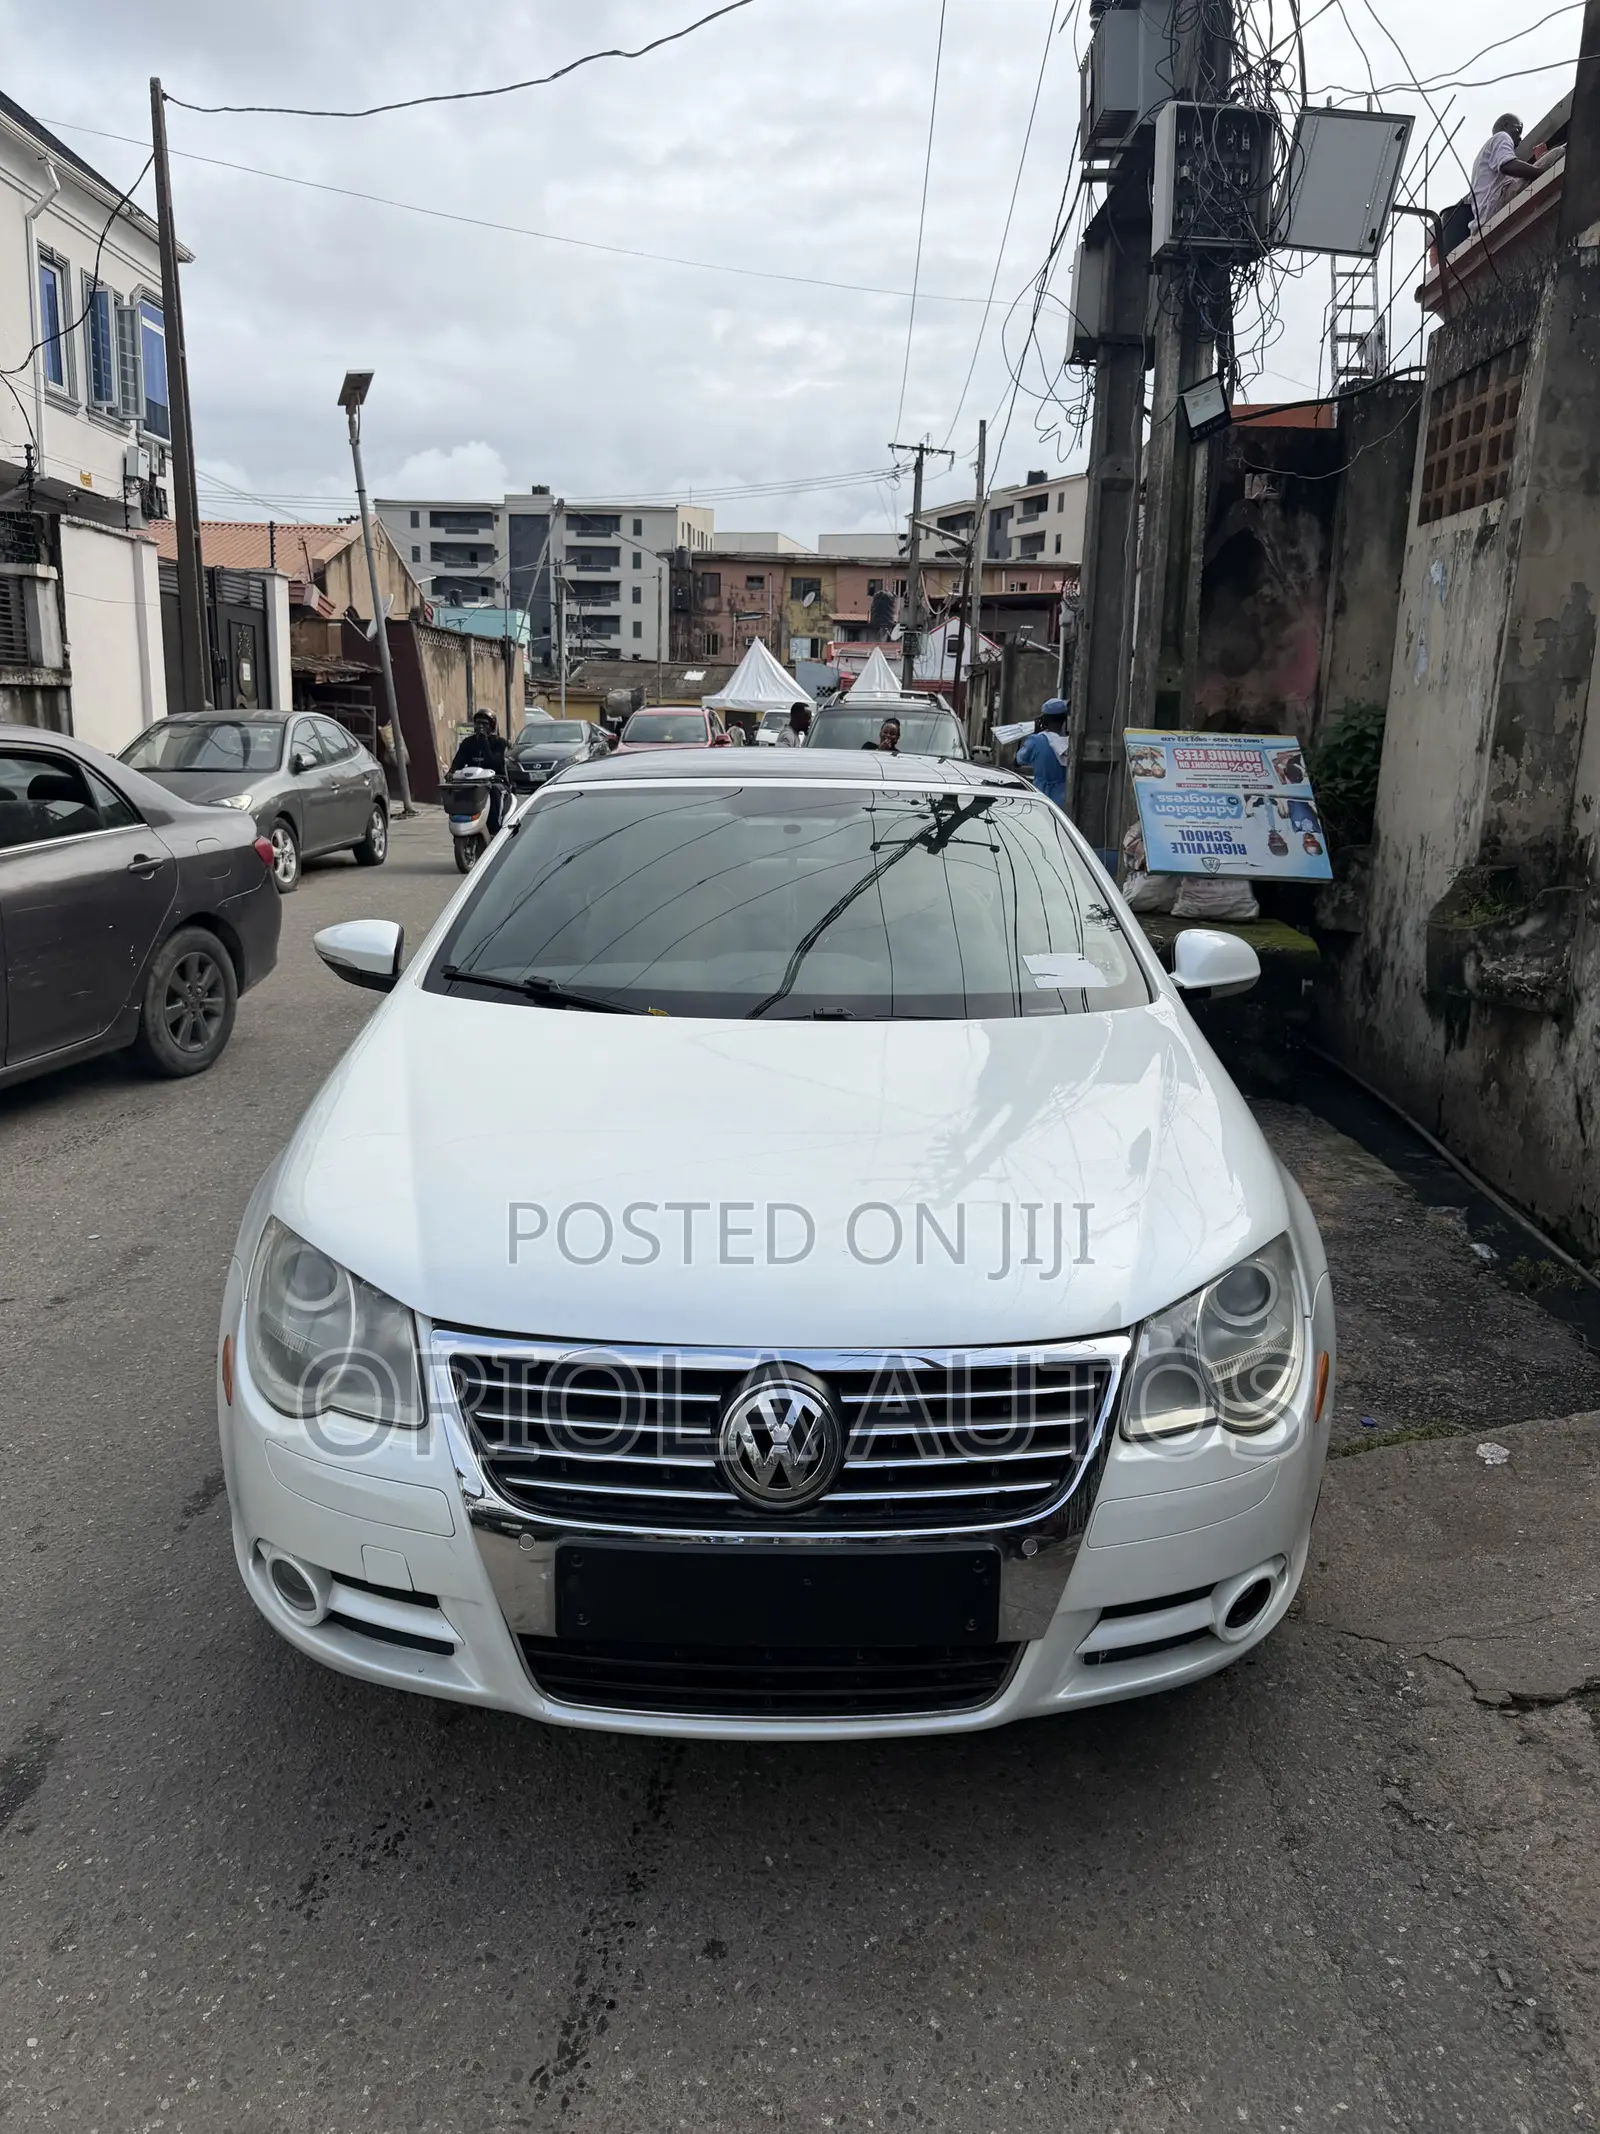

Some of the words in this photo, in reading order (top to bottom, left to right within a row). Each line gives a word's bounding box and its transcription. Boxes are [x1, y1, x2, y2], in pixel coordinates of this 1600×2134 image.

[1174, 749, 1206, 761] FEES
[1208, 750, 1261, 761] JOINING
[1179, 760, 1190, 769] ON
[1191, 760, 1228, 769] DISCOUNT
[1228, 761, 1263, 772] 50%
[1157, 793, 1227, 805] Progress
[1154, 804, 1239, 816] Admission
[1178, 829, 1233, 842] SCHOOL
[1170, 842, 1247, 855] RIGHTVILLE
[727, 1388, 830, 1495] VW
